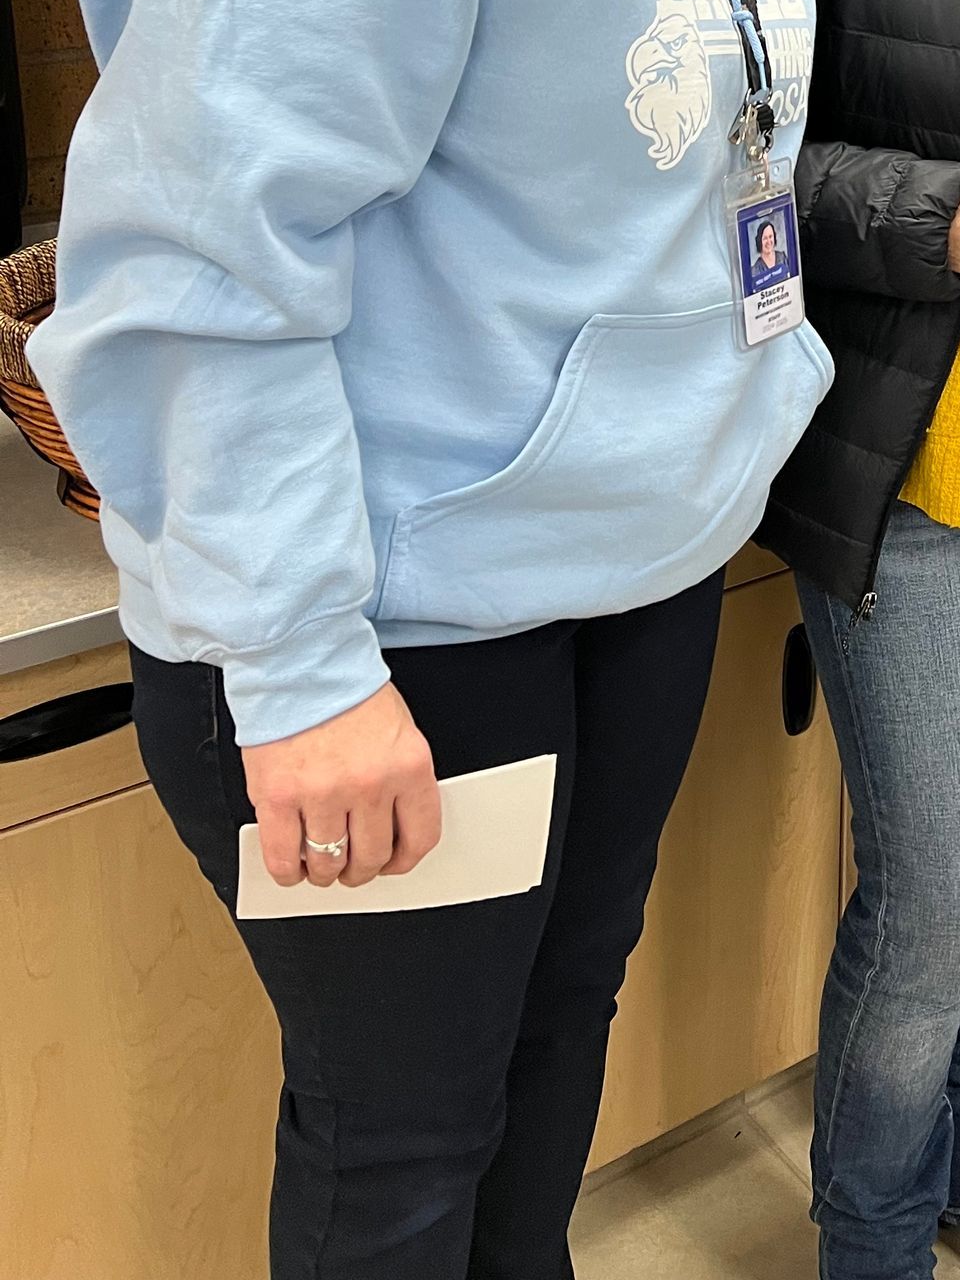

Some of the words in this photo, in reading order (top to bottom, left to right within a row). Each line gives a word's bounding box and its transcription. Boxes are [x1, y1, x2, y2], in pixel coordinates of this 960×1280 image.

[766, 27, 813, 81] HING
[773, 76, 809, 126] OSA
[757, 292, 790, 311] Peterson
[760, 285, 785, 300] Stacey
